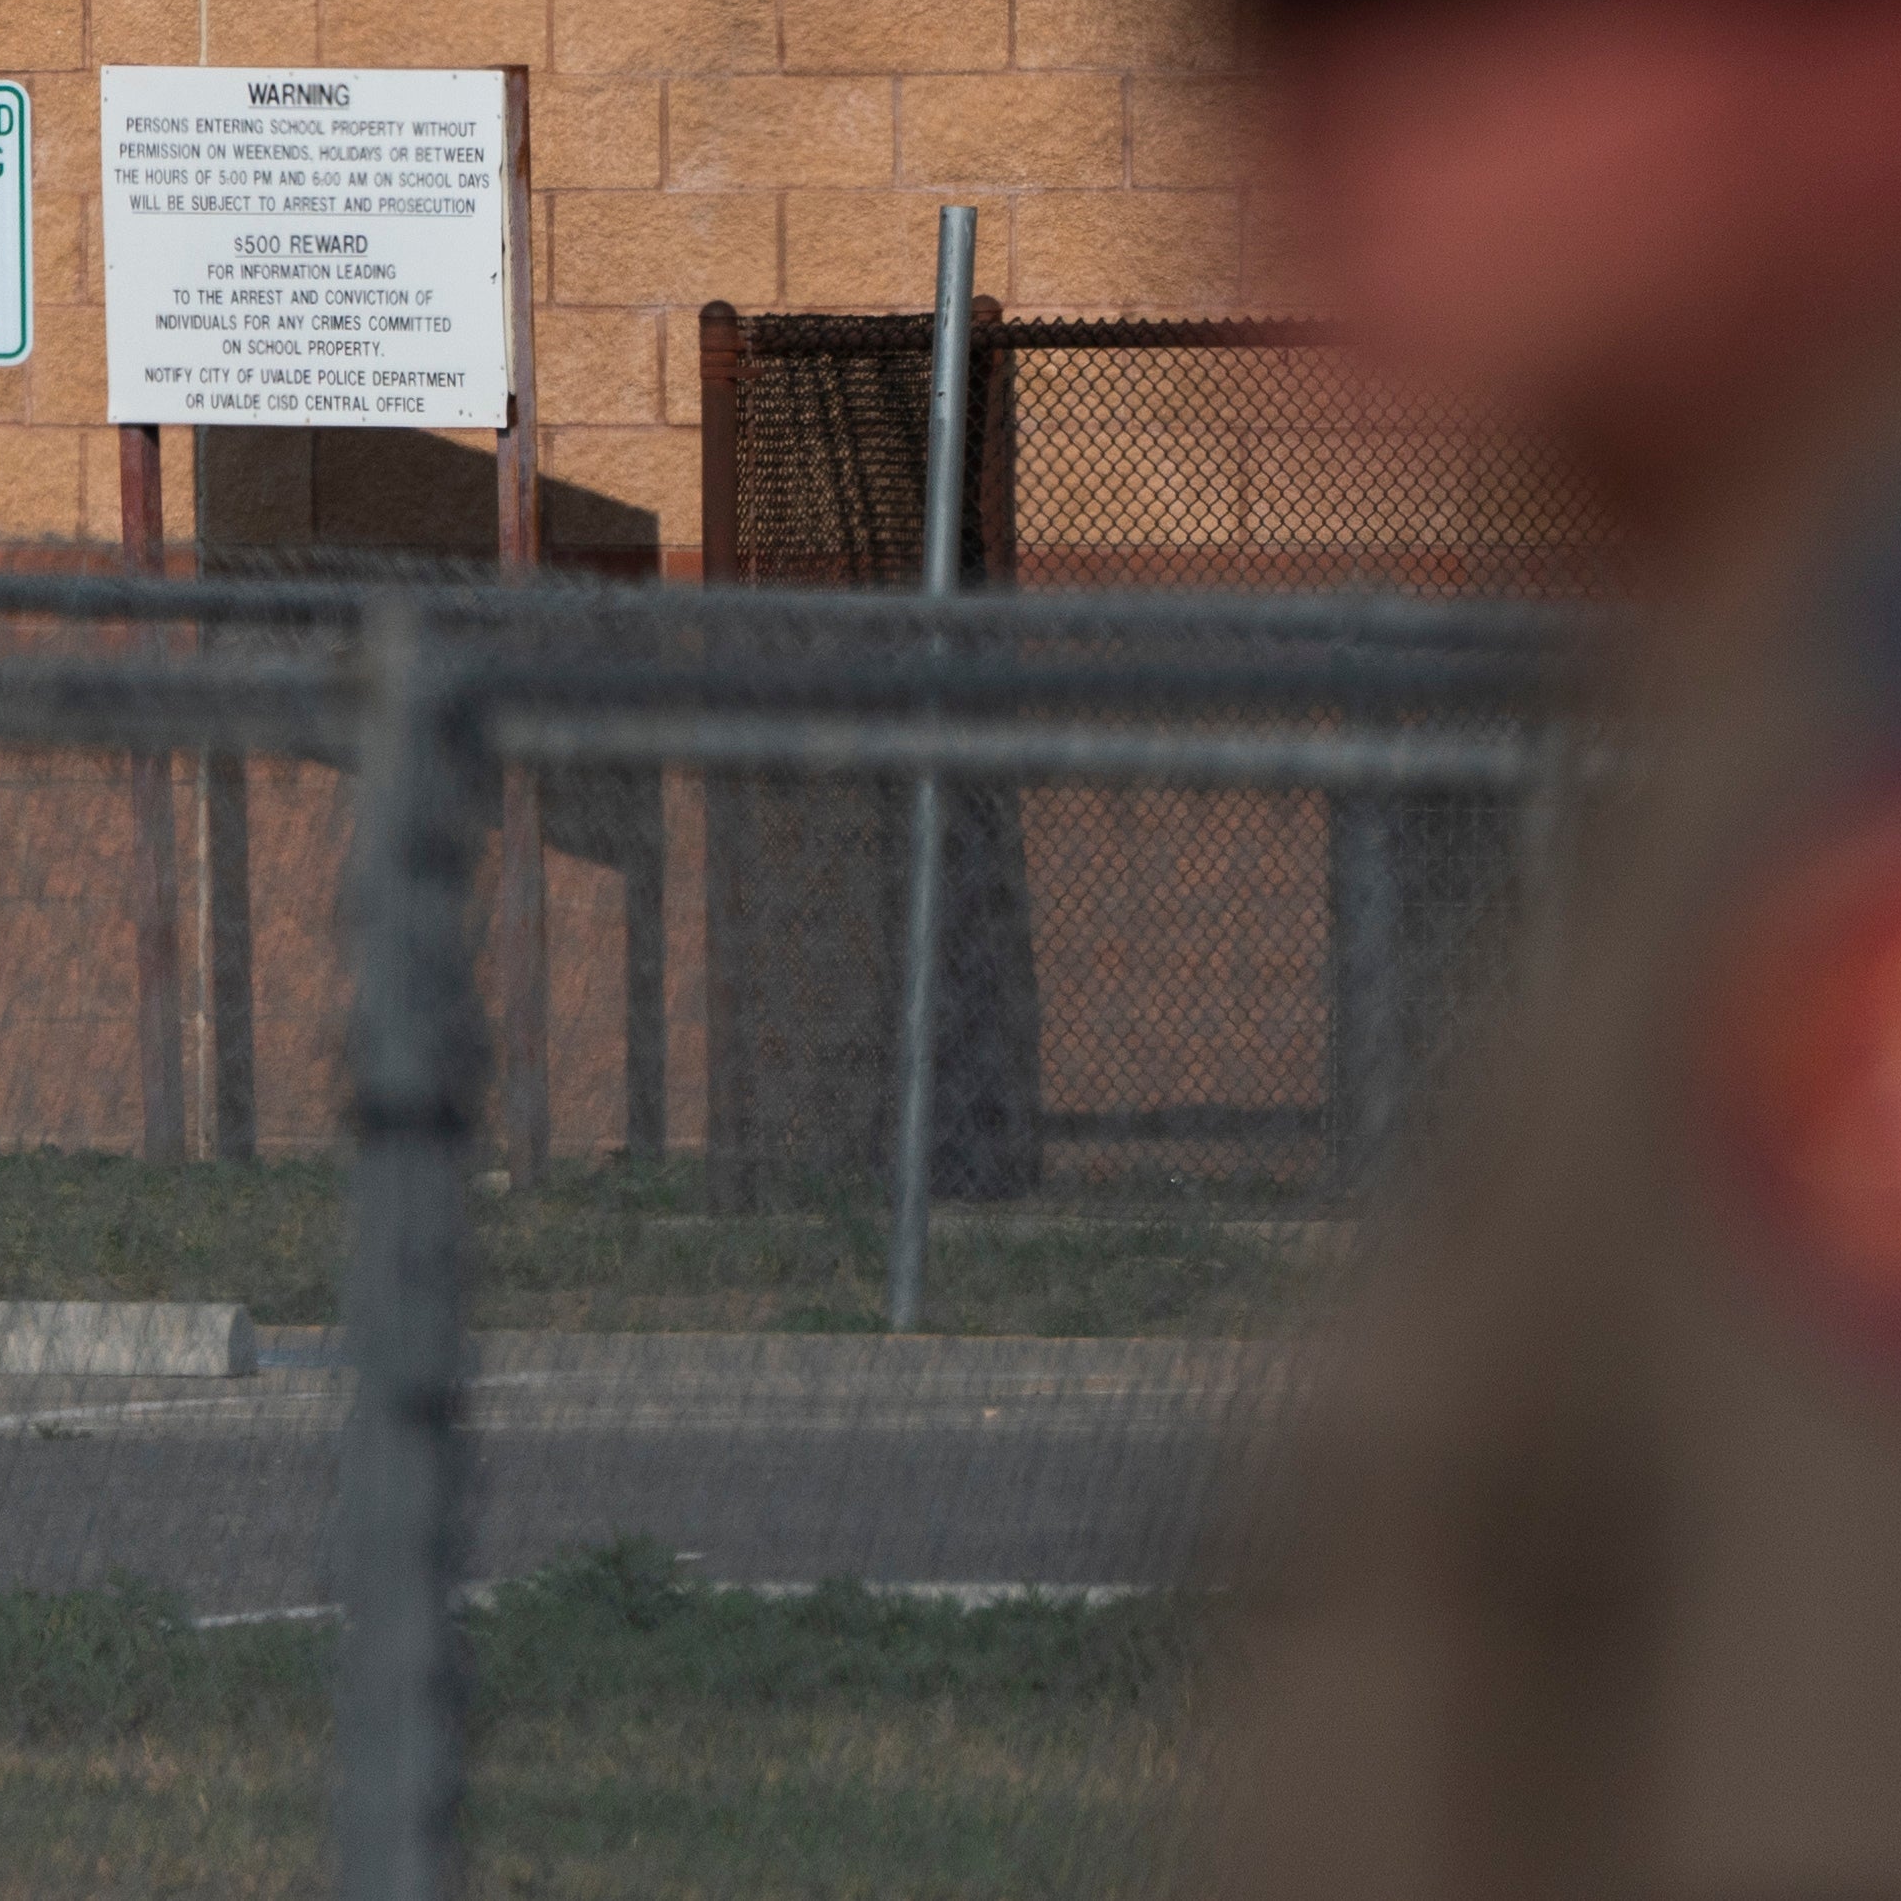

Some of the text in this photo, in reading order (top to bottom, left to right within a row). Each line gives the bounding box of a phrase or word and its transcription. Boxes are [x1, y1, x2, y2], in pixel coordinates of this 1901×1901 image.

[248, 82, 350, 106] WARNING
[126, 118, 476, 137] PERSONS ENTERING SCHOOL PROPERTY WITHOUT
[120, 144, 200, 159] PERMISSION
[207, 144, 226, 159] ON
[319, 147, 382, 161] HOLIDAYS
[390, 147, 408, 162] OR
[415, 148, 484, 163] BETWEEN
[114, 169, 490, 188] THE HOURS OF 5:00 PM AND 6:00 AM ON SCHOOL DAYS
[130, 195, 475, 213] WILL BE SUBJECT TO ARREST AND PROSECUTION
[234, 235, 368, 254] $500 REWARD
[208, 264, 396, 279] FOR INFORMATION LEADING
[173, 290, 433, 305] TO THE ARREST AND CONVICTION OF
[156, 315, 451, 332] INDIVIDUALS FOR ANY CRIMES COMMITTED
[222, 340, 384, 356] ON SCHOOL PROPERTY.
[145, 367, 465, 387] NOTIFY CITY OF UVALDE POLICE DEPARTMENT
[186, 394, 425, 412] OR UVALDE CISD CENTRAL OFFICE
